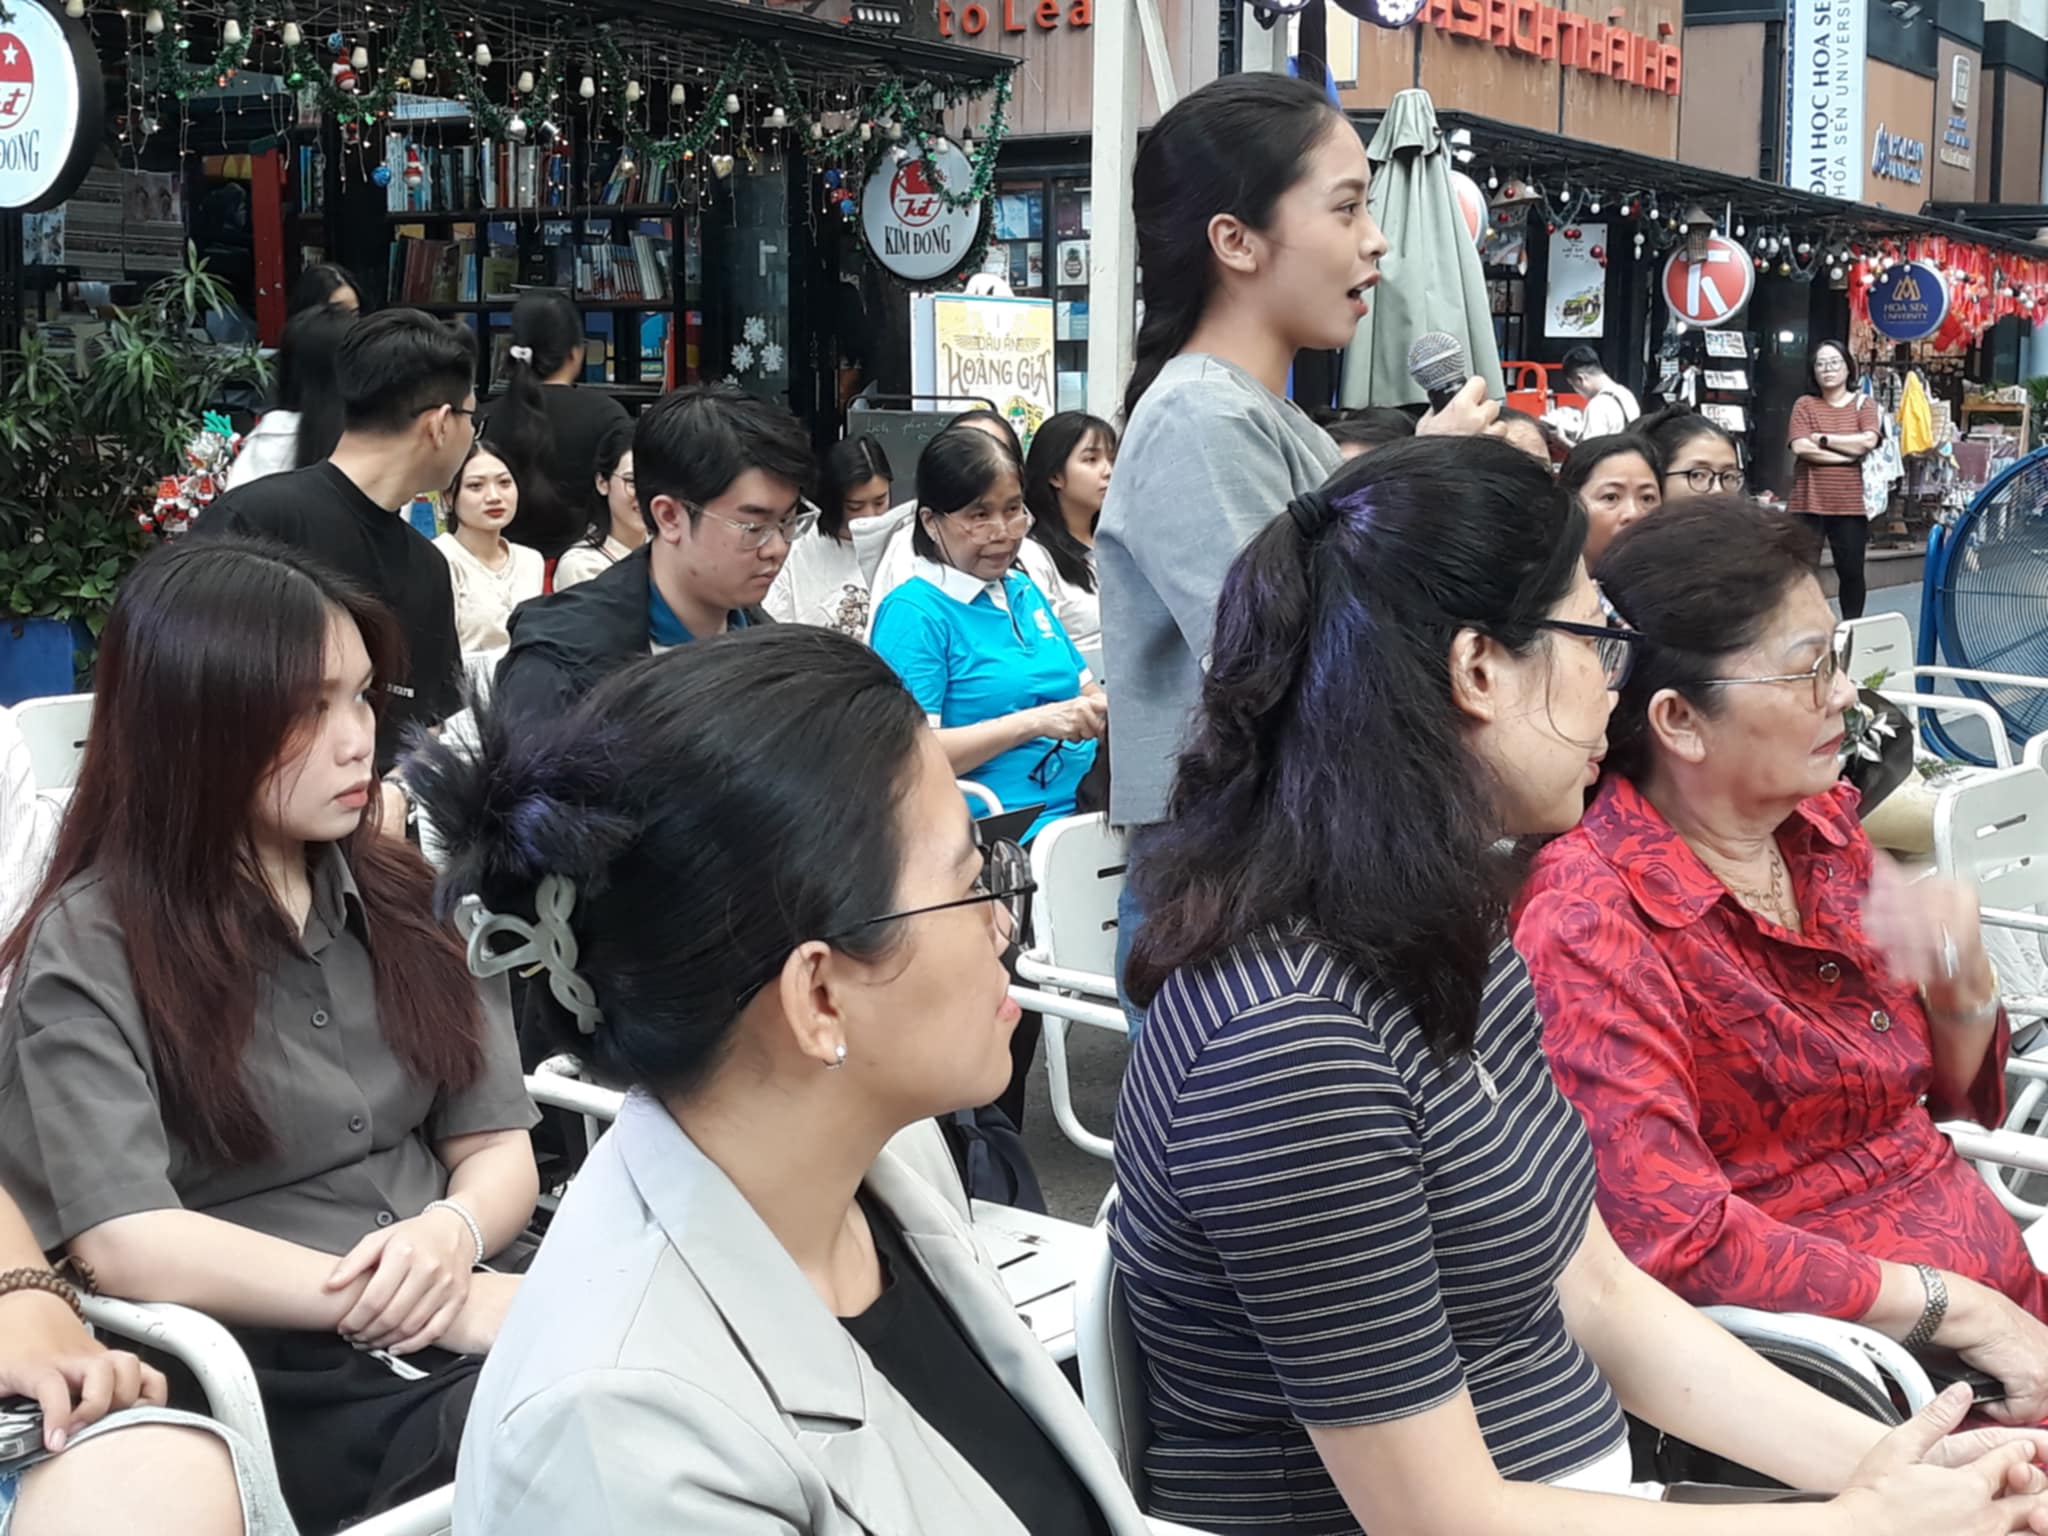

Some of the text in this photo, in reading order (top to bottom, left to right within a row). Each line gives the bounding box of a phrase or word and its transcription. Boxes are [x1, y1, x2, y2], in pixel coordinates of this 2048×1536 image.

[1812, 33, 1831, 87] HOA
[1834, 107, 1848, 145] SEN
[1833, 155, 1847, 197] HOA
[885, 225, 910, 255] KIM
[1883, 303, 1907, 312] HOA
